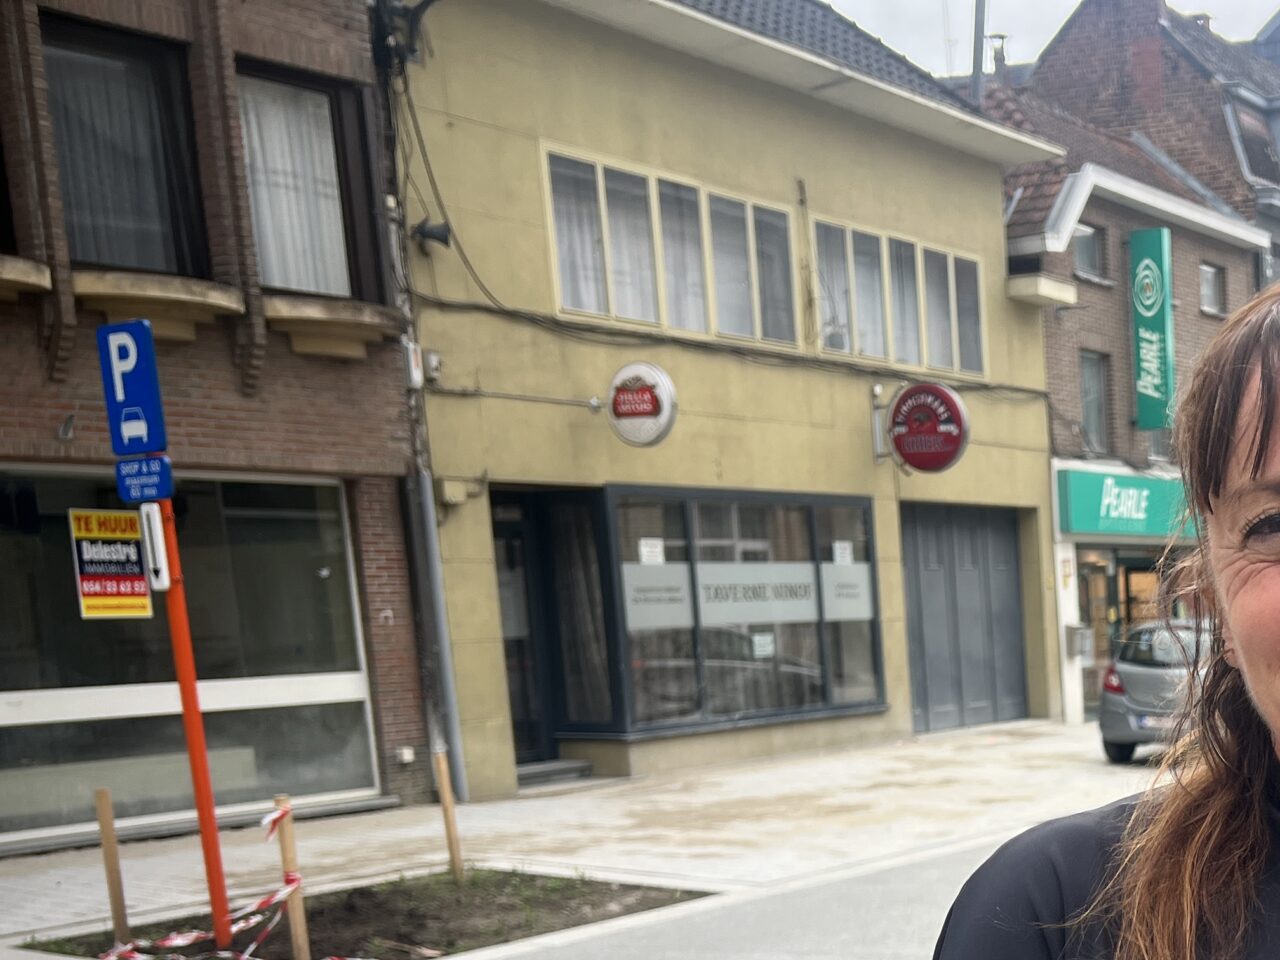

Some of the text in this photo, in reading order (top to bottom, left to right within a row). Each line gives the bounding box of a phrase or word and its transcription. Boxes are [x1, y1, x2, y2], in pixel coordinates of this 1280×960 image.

[107, 331, 138, 403] P
[1136, 327, 1162, 398] PEARLE
[1100, 477, 1149, 519] PEARLE
[74, 515, 138, 534] TE HUUR
[703, 583, 769, 603] TAVERNE
